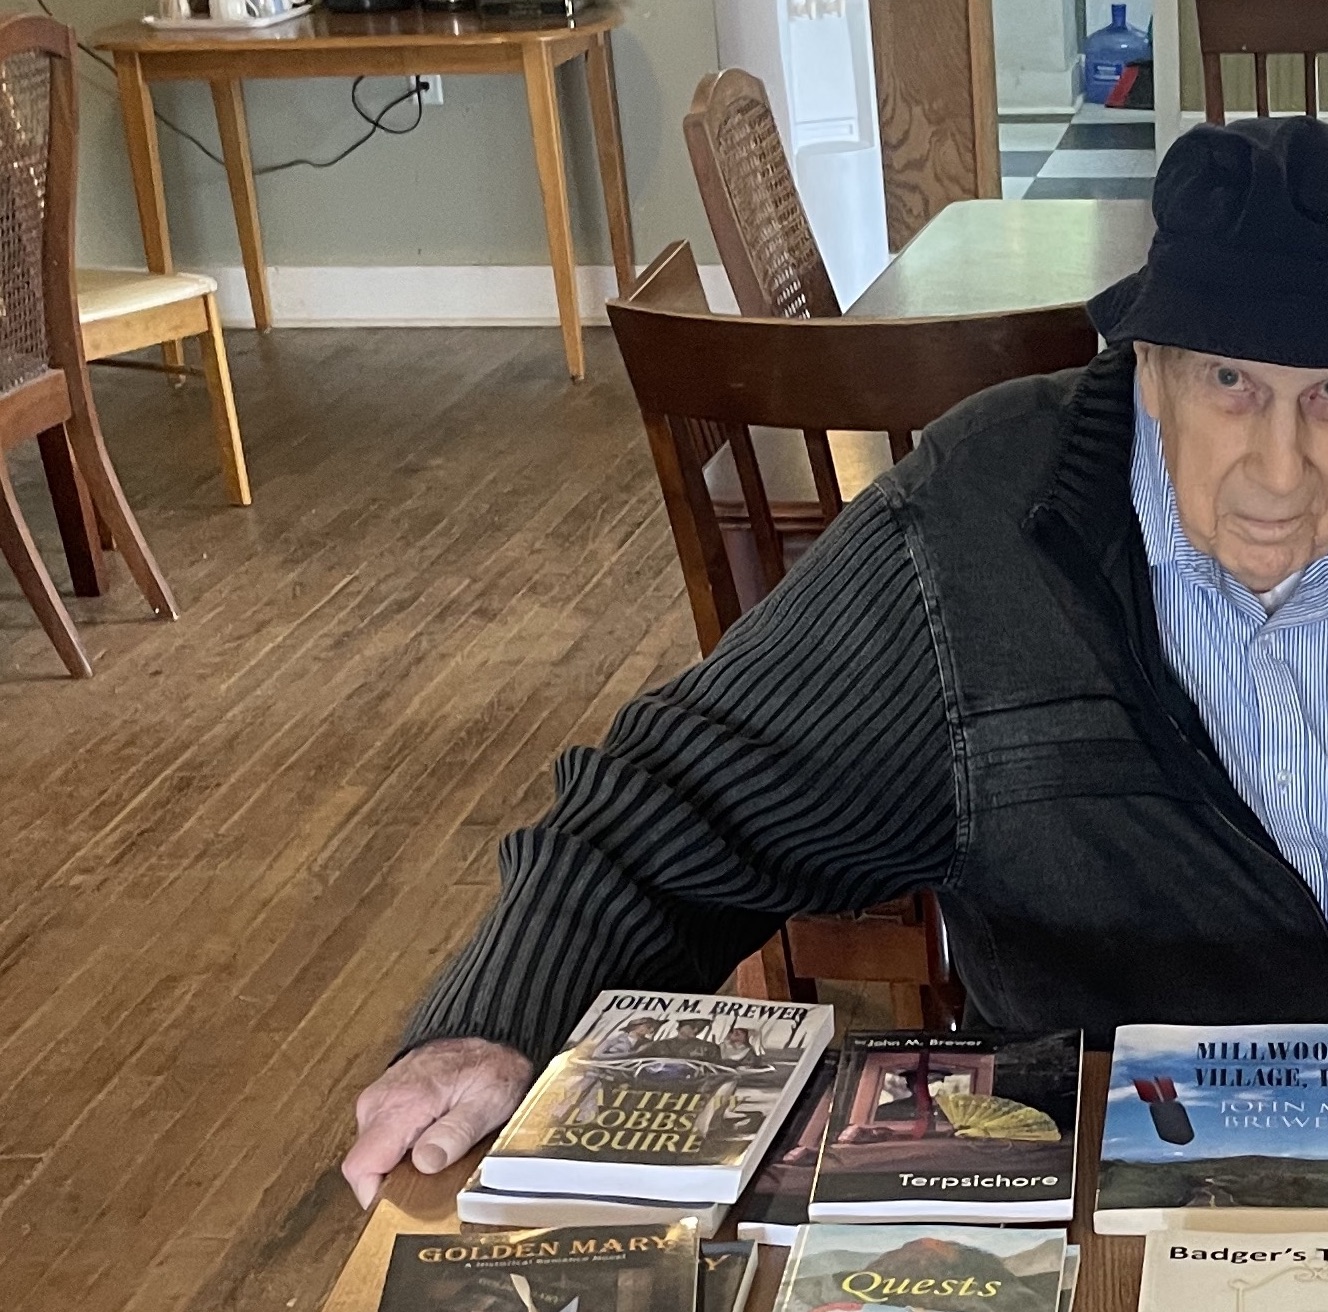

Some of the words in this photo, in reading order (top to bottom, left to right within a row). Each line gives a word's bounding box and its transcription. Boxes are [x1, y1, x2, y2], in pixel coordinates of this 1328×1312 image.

[602, 994, 674, 1013] JOHN
[675, 998, 702, 1015] M.
[708, 1000, 808, 1022] BREWER
[867, 1039, 900, 1047] John
[1194, 1068, 1308, 1089] VILLAGE,
[1220, 1100, 1306, 1114] JOHN
[539, 1127, 702, 1153] ESQUIRE
[898, 1173, 1059, 1190] Terpsichore
[417, 1241, 559, 1263] GOLDEN
[569, 1235, 674, 1255] MARY
[1169, 1245, 1307, 1264] Badger's
[841, 1270, 1002, 1303] Quests
